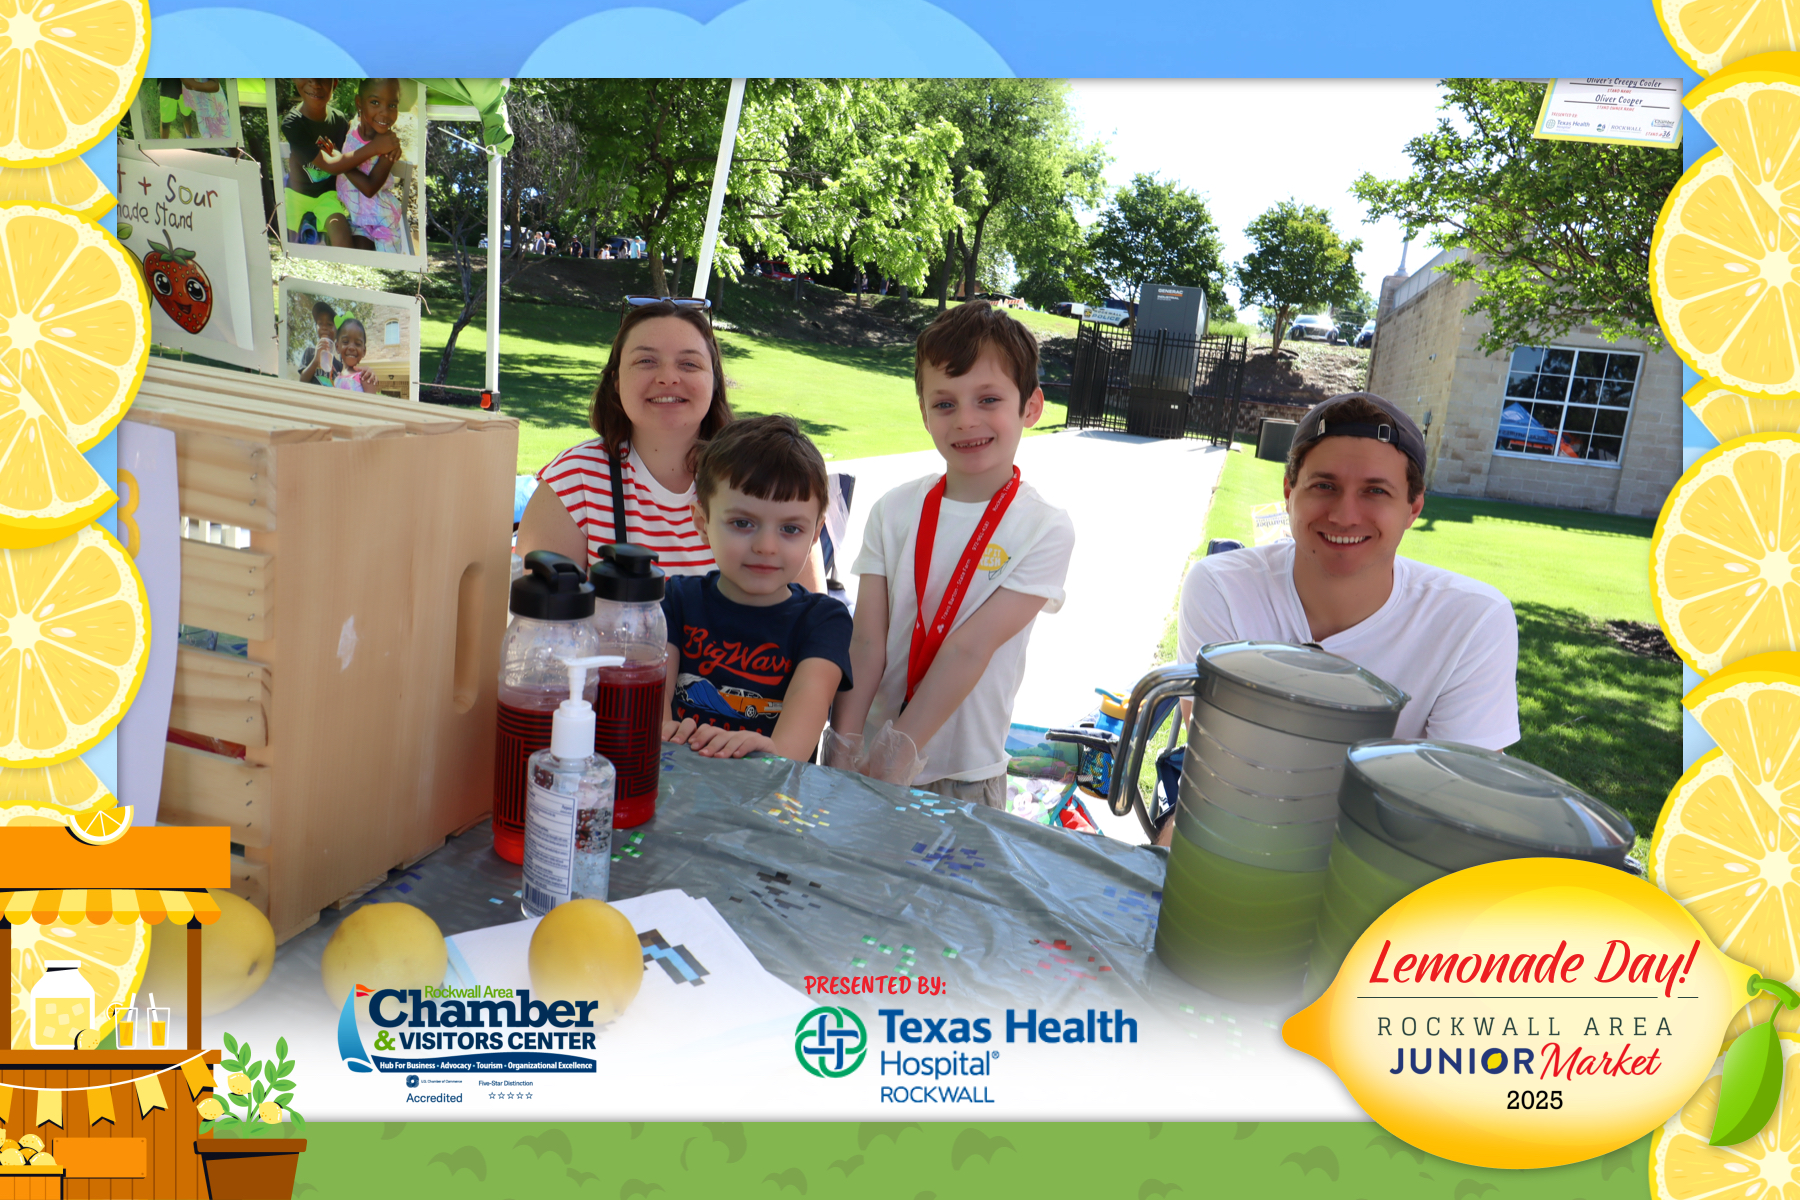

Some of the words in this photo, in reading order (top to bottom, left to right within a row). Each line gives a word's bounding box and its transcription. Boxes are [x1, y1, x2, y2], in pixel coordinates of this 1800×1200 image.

[1614, 78, 1638, 88] Creepy
[1640, 79, 1662, 88] Cooler
[1595, 94, 1617, 103] Oliver
[1618, 96, 1643, 106] Cooper
[165, 174, 218, 208] Sour
[155, 202, 194, 232] Stand
[956, 571, 966, 585] State
[963, 558, 972, 572] Farm
